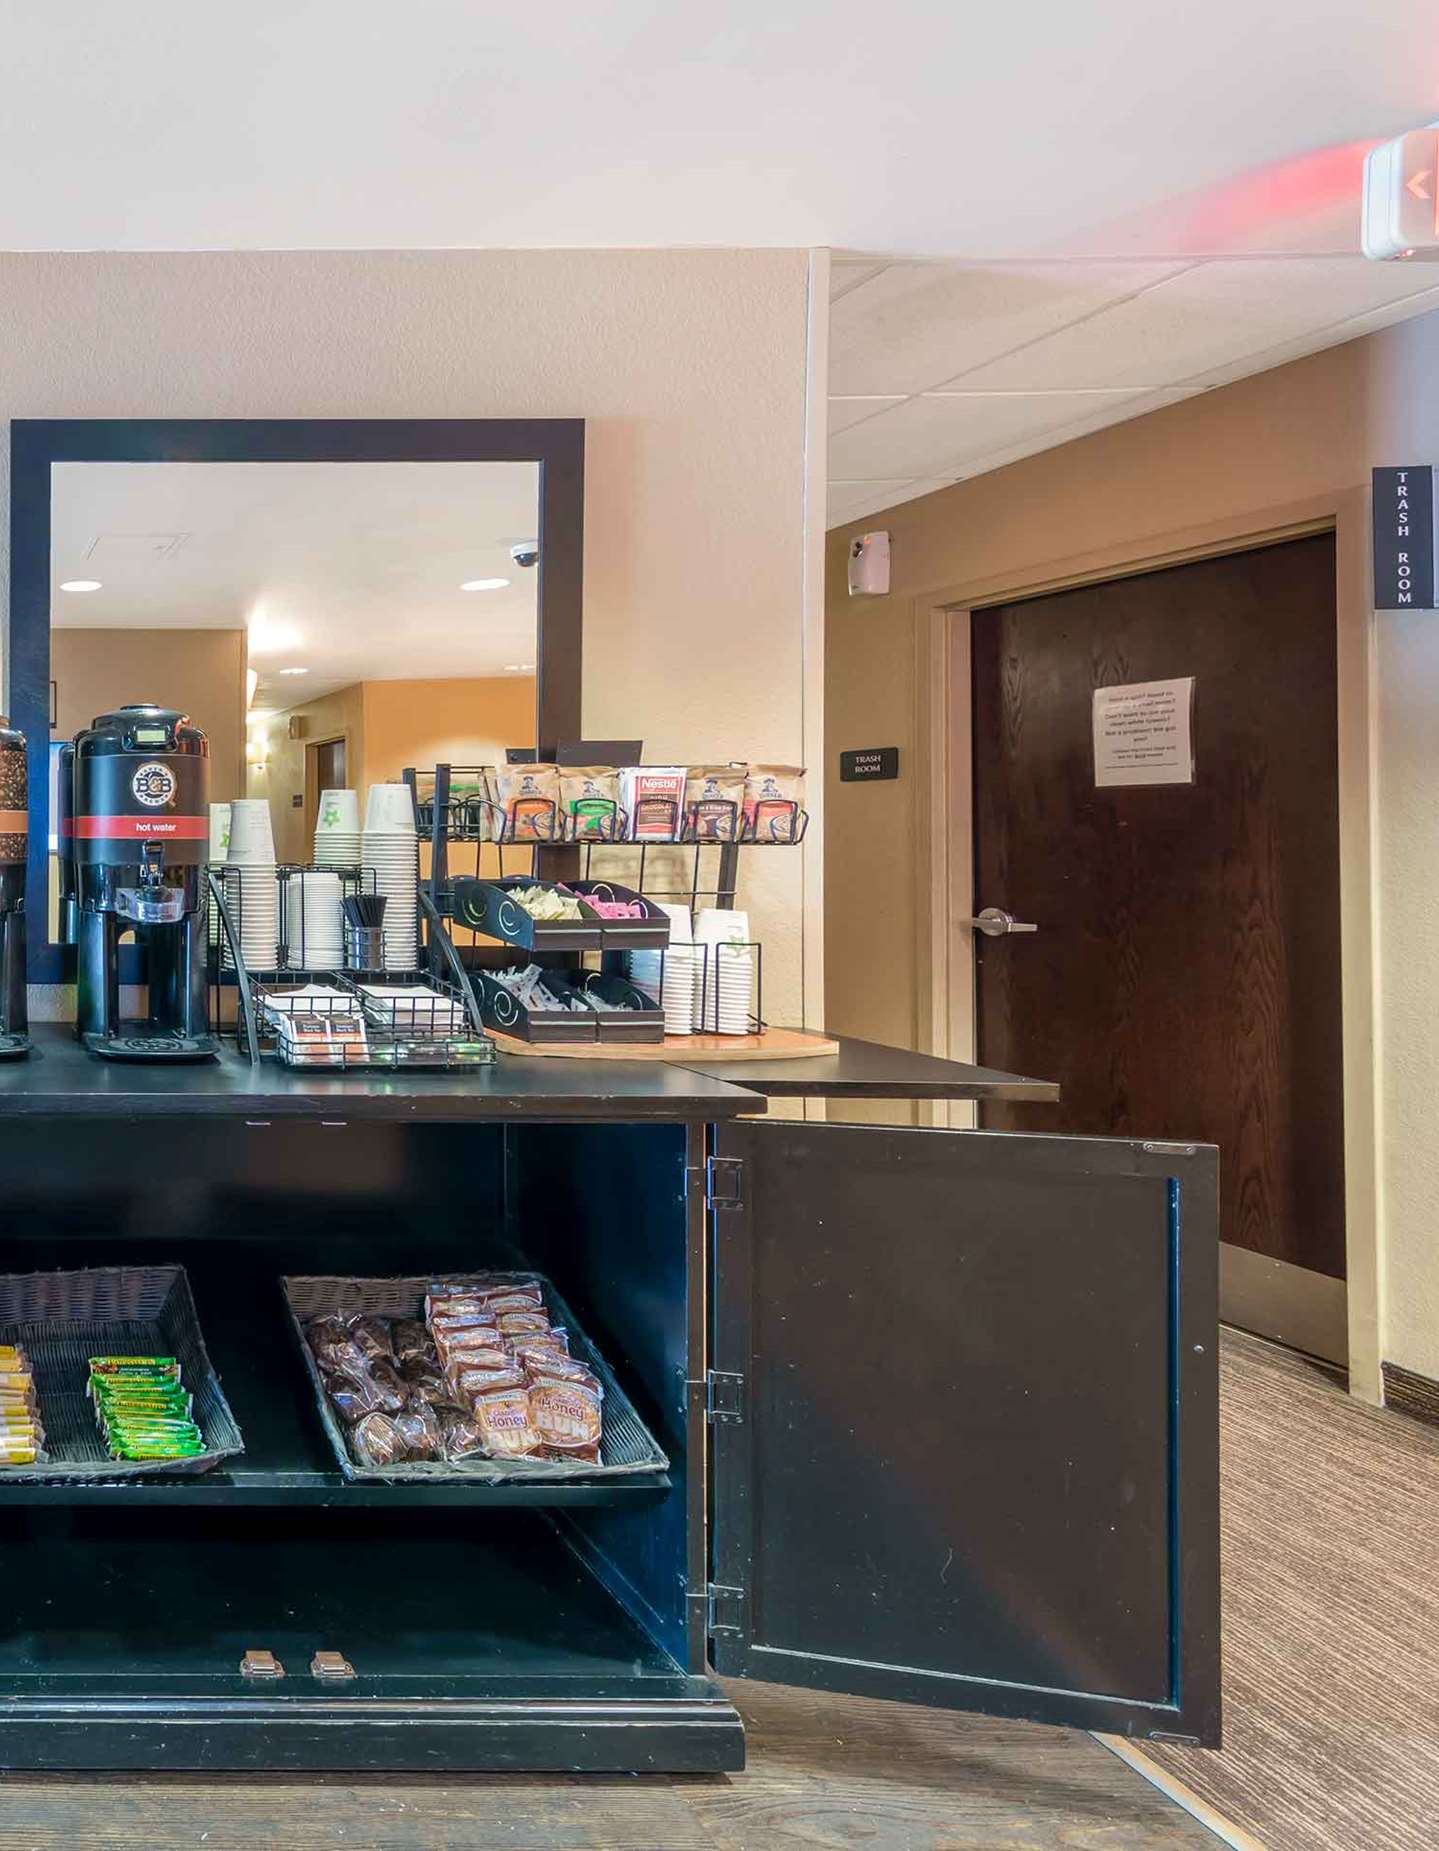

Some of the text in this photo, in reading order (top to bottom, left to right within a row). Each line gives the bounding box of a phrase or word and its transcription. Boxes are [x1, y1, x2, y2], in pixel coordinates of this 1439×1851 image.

[1397, 472, 1412, 603] TRASH ROOM
[856, 755, 881, 764] TRASH
[855, 764, 881, 773] ROOM
[136, 823, 177, 832] hot water
[541, 1397, 584, 1421] Honey
[486, 1415, 528, 1429] Honey
